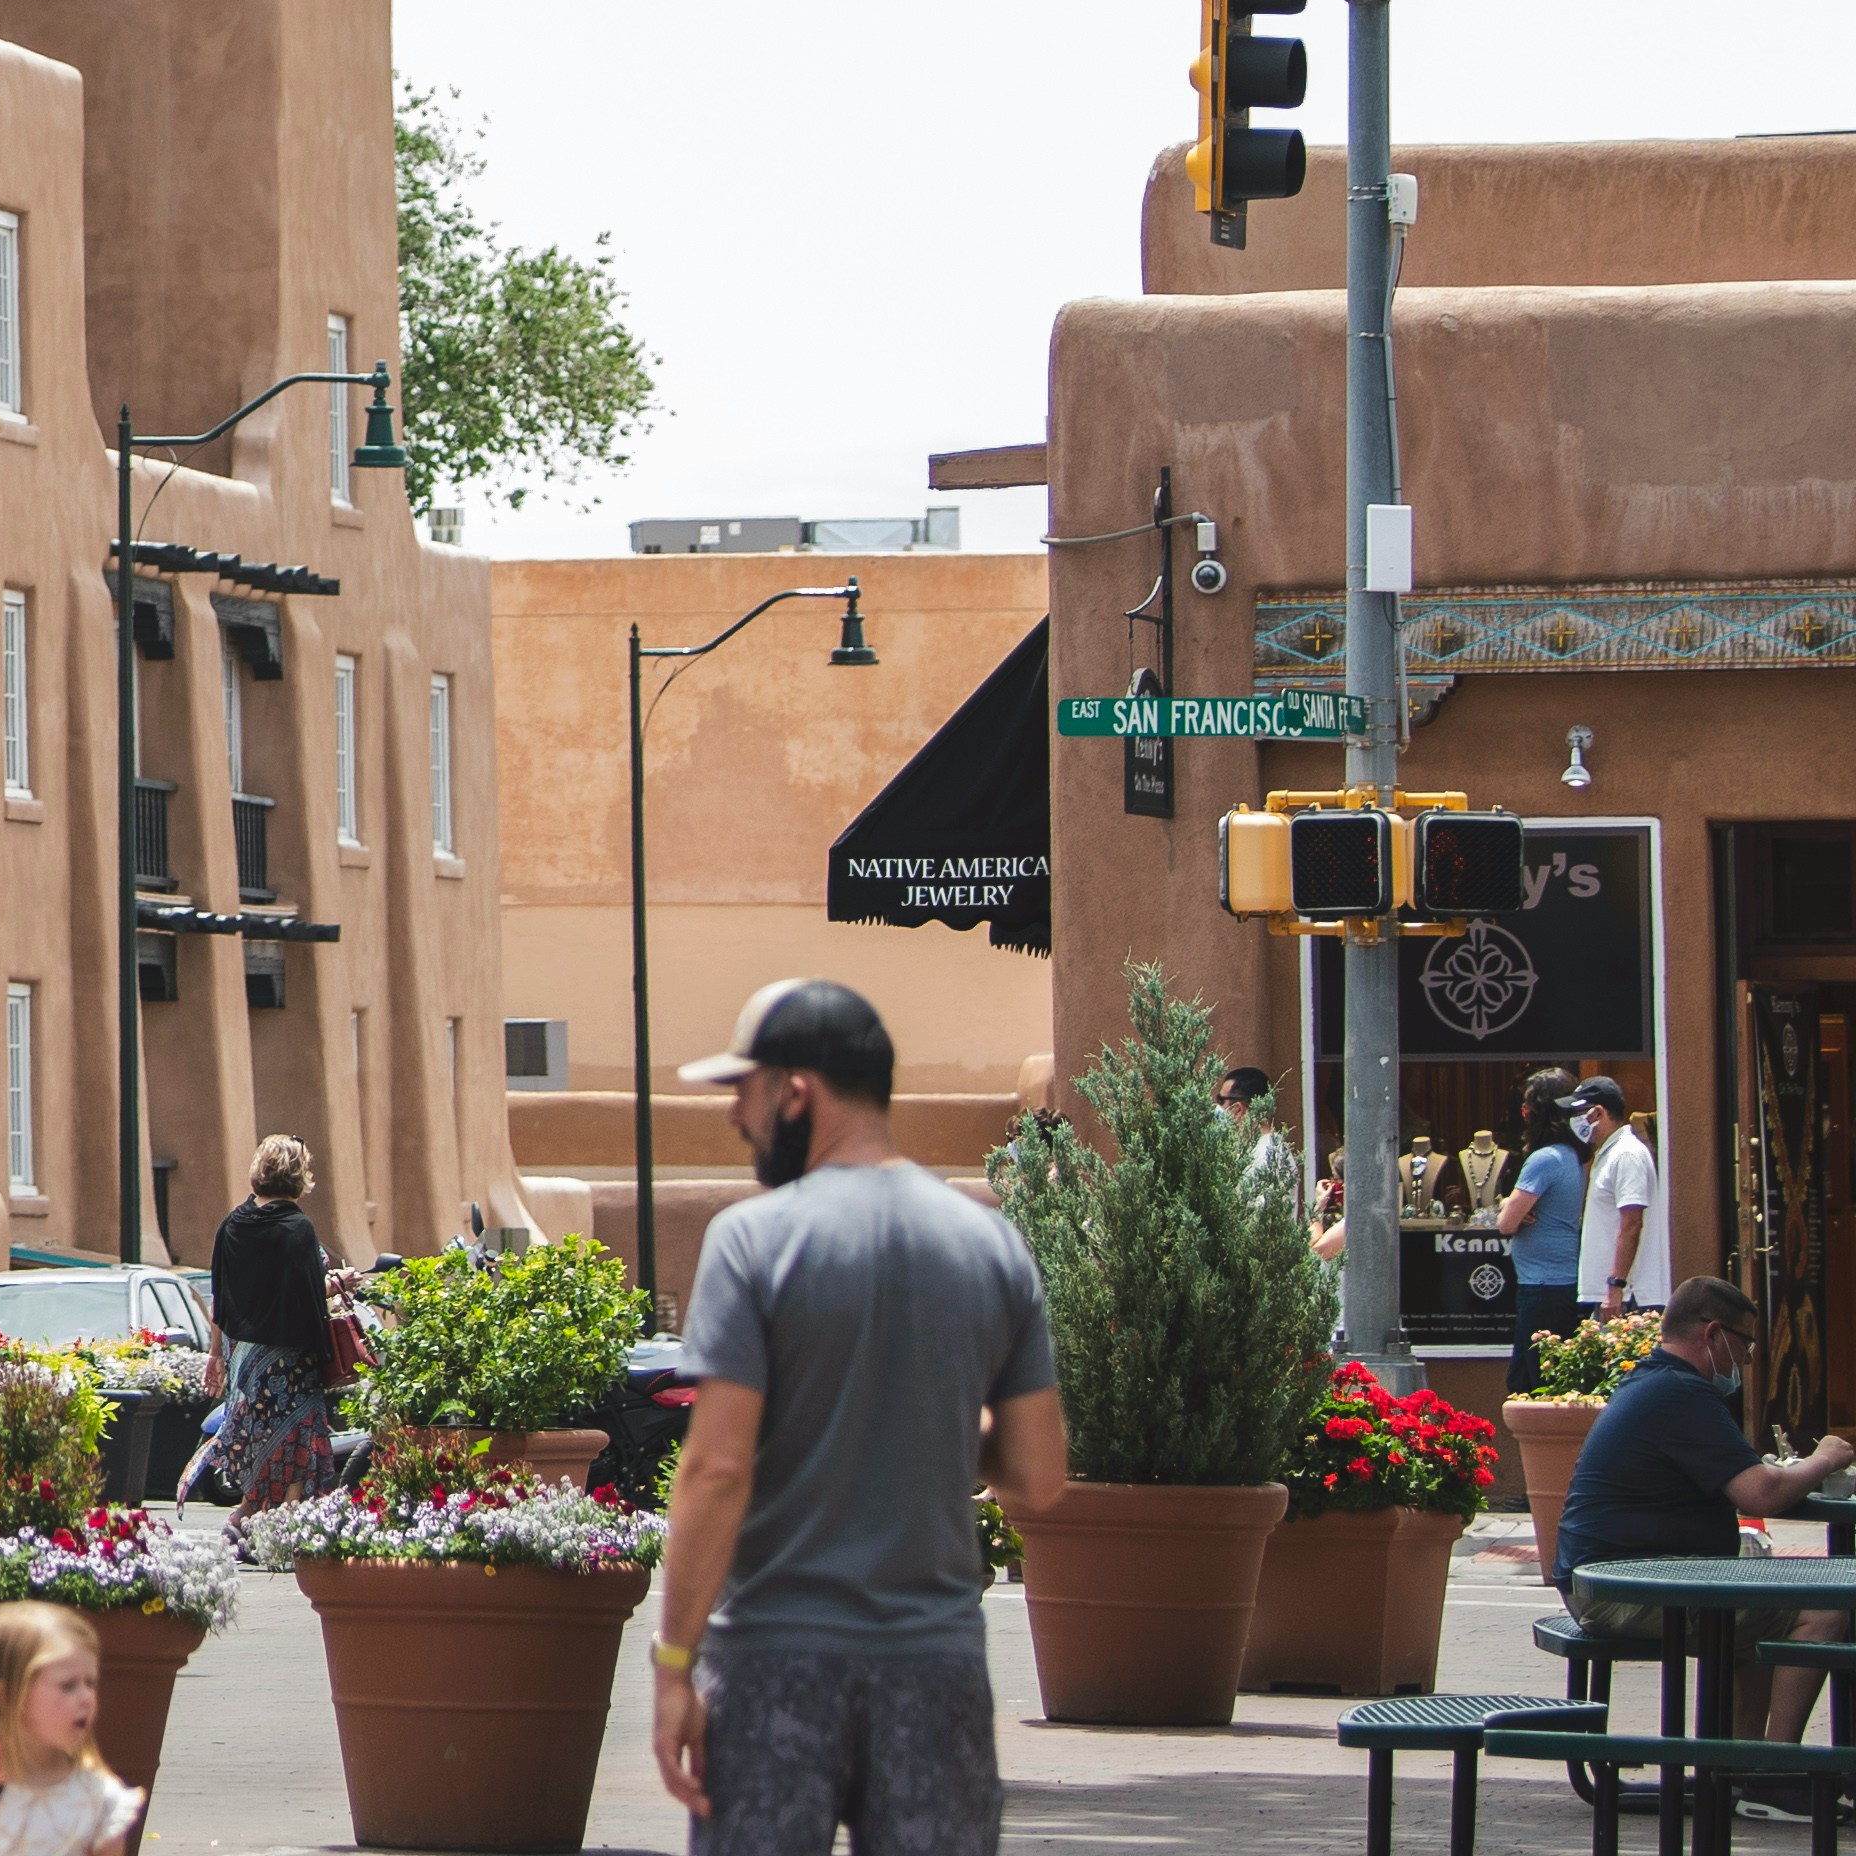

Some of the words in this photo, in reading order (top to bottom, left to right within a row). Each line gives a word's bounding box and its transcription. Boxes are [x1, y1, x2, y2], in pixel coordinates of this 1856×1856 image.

[1072, 700, 1101, 719] EAST
[1113, 700, 1158, 735] SAN
[1171, 700, 1303, 736] FRANCISC
[1288, 691, 1300, 710] OLD
[1302, 693, 1335, 730] SANTA
[1339, 697, 1349, 732] FE
[848, 857, 936, 879] NATIVE
[939, 856, 1051, 879] AMERICA
[901, 884, 1014, 907] JEWELRY
[1434, 1233, 1512, 1256] Kenny
